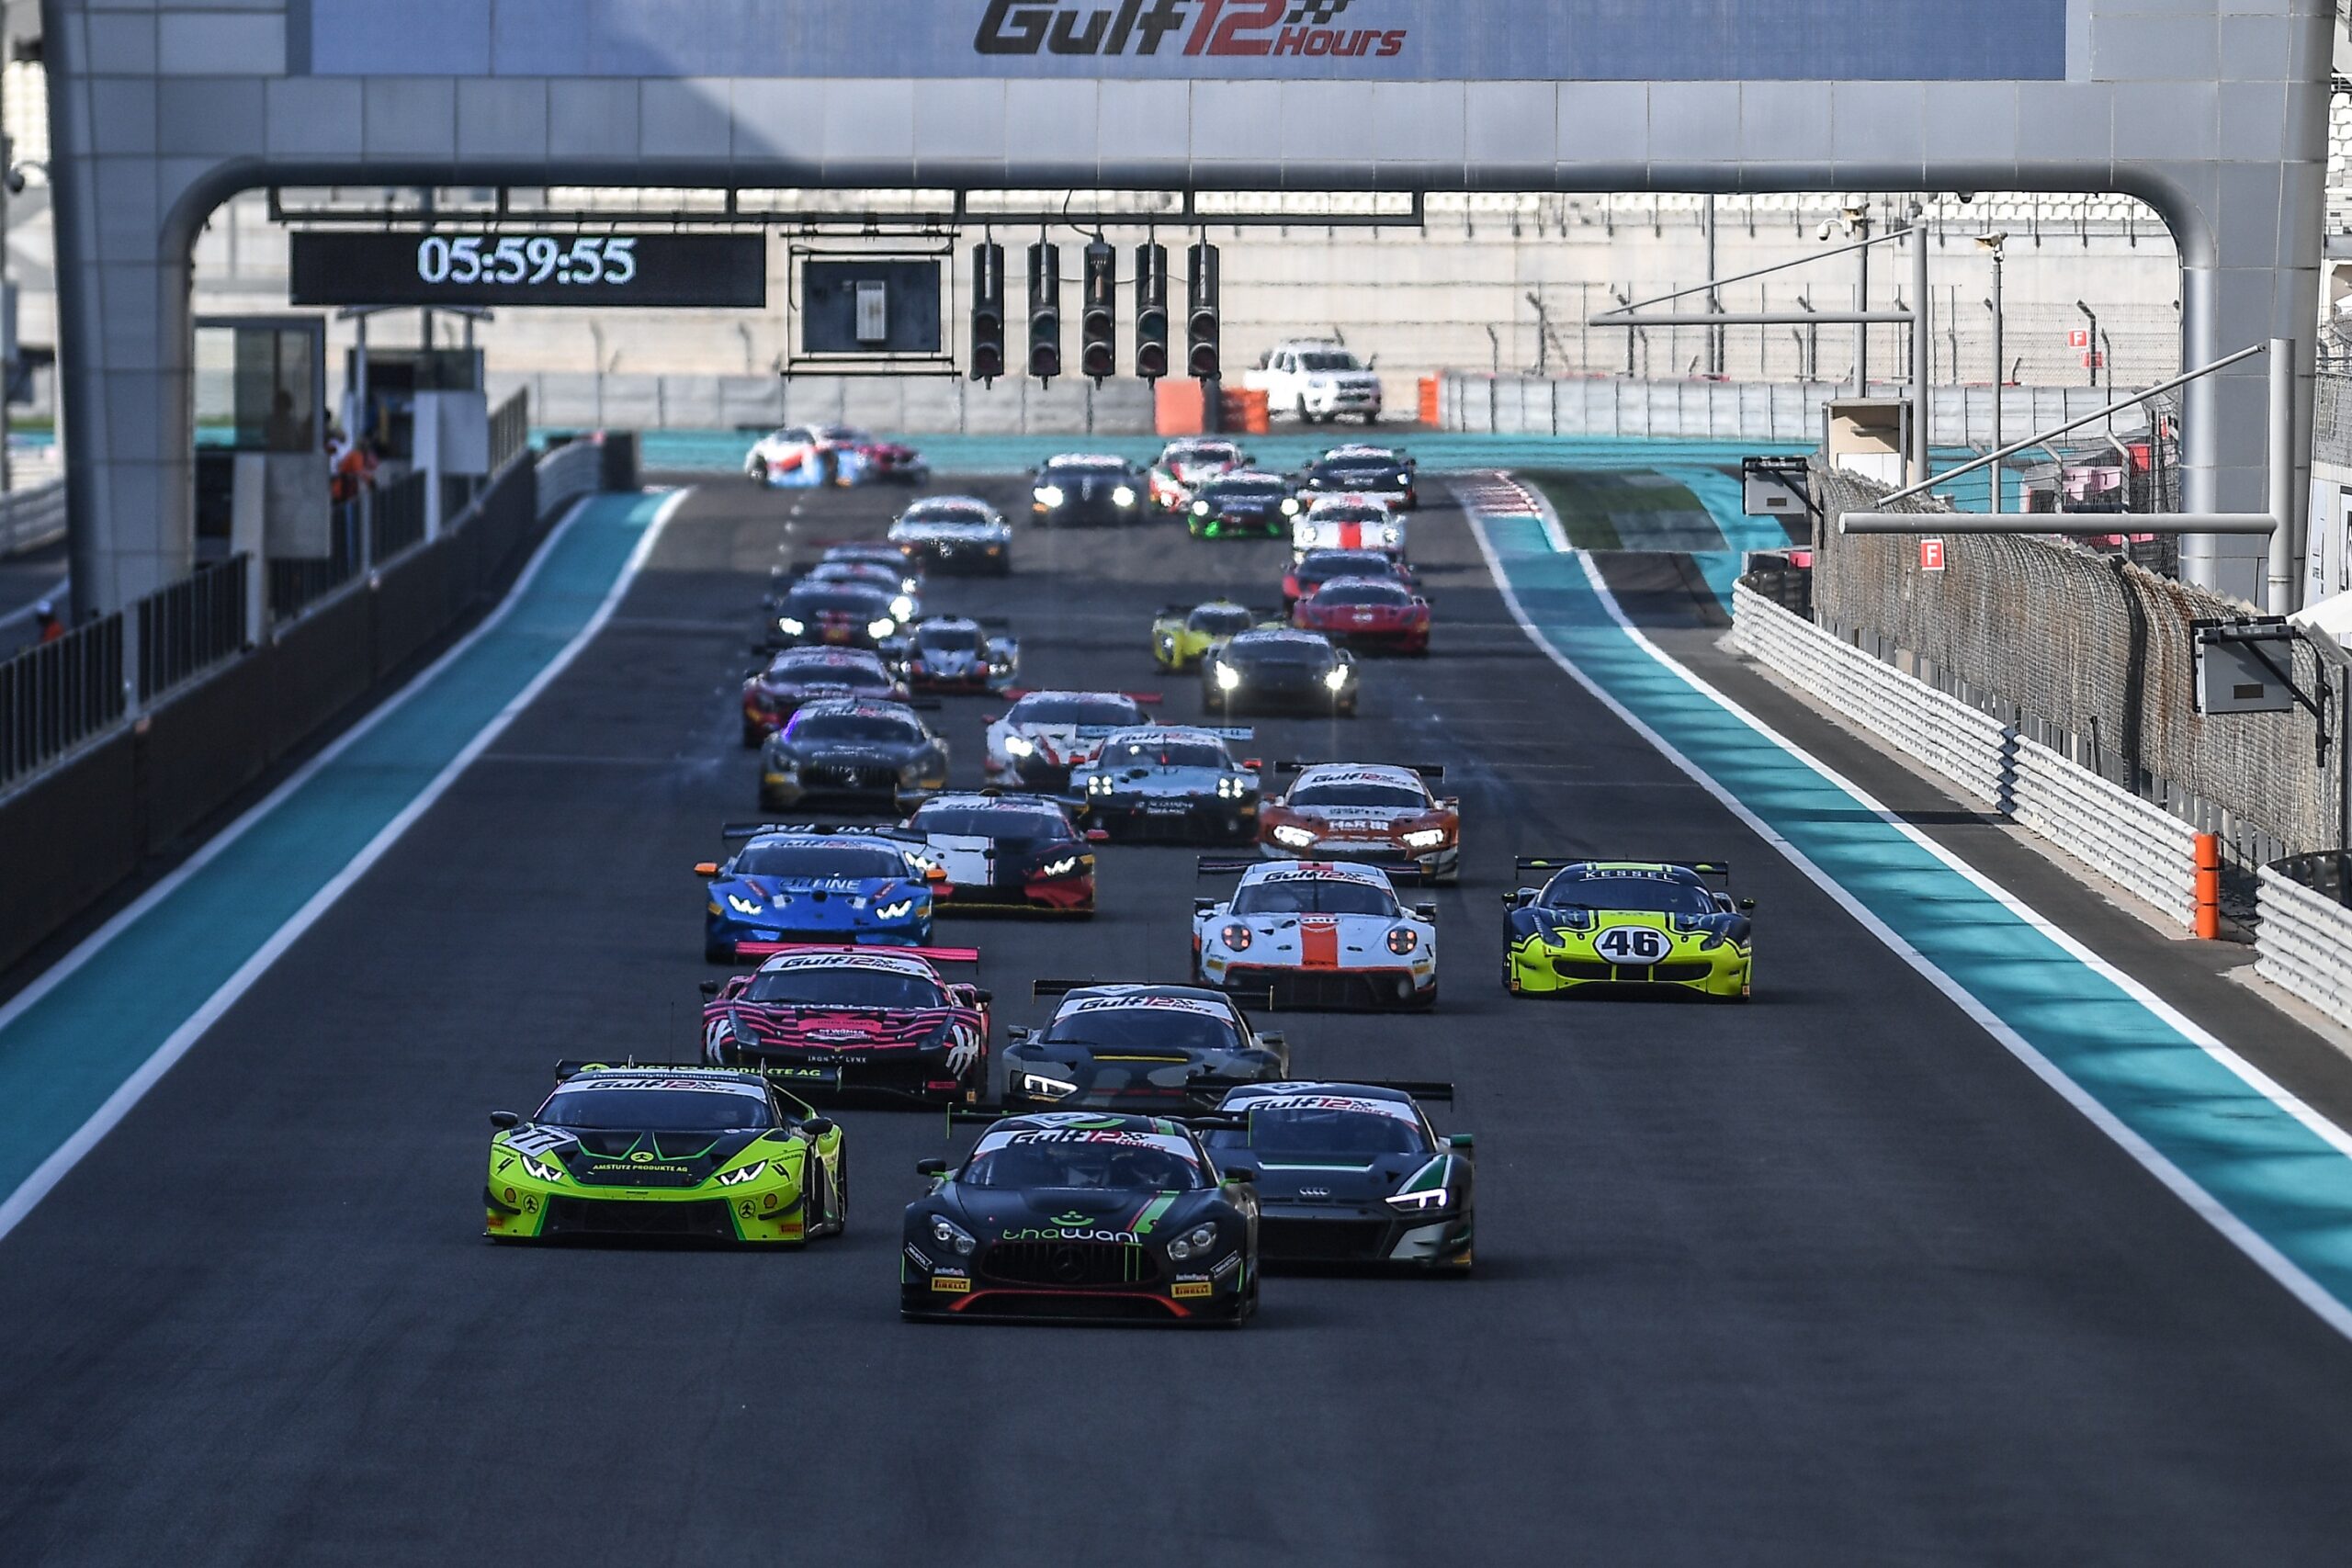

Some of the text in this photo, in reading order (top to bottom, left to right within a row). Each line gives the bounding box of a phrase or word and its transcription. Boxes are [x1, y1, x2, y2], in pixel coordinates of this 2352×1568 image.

[1274, 27, 1407, 57] Hours
[417, 236, 638, 285] 05:59:55
[2074, 332, 2084, 345] F
[1927, 545, 1938, 566] F
[1586, 869, 1674, 881] KESSEL
[1601, 930, 1659, 958] 46
[512, 1128, 568, 1150] 77
